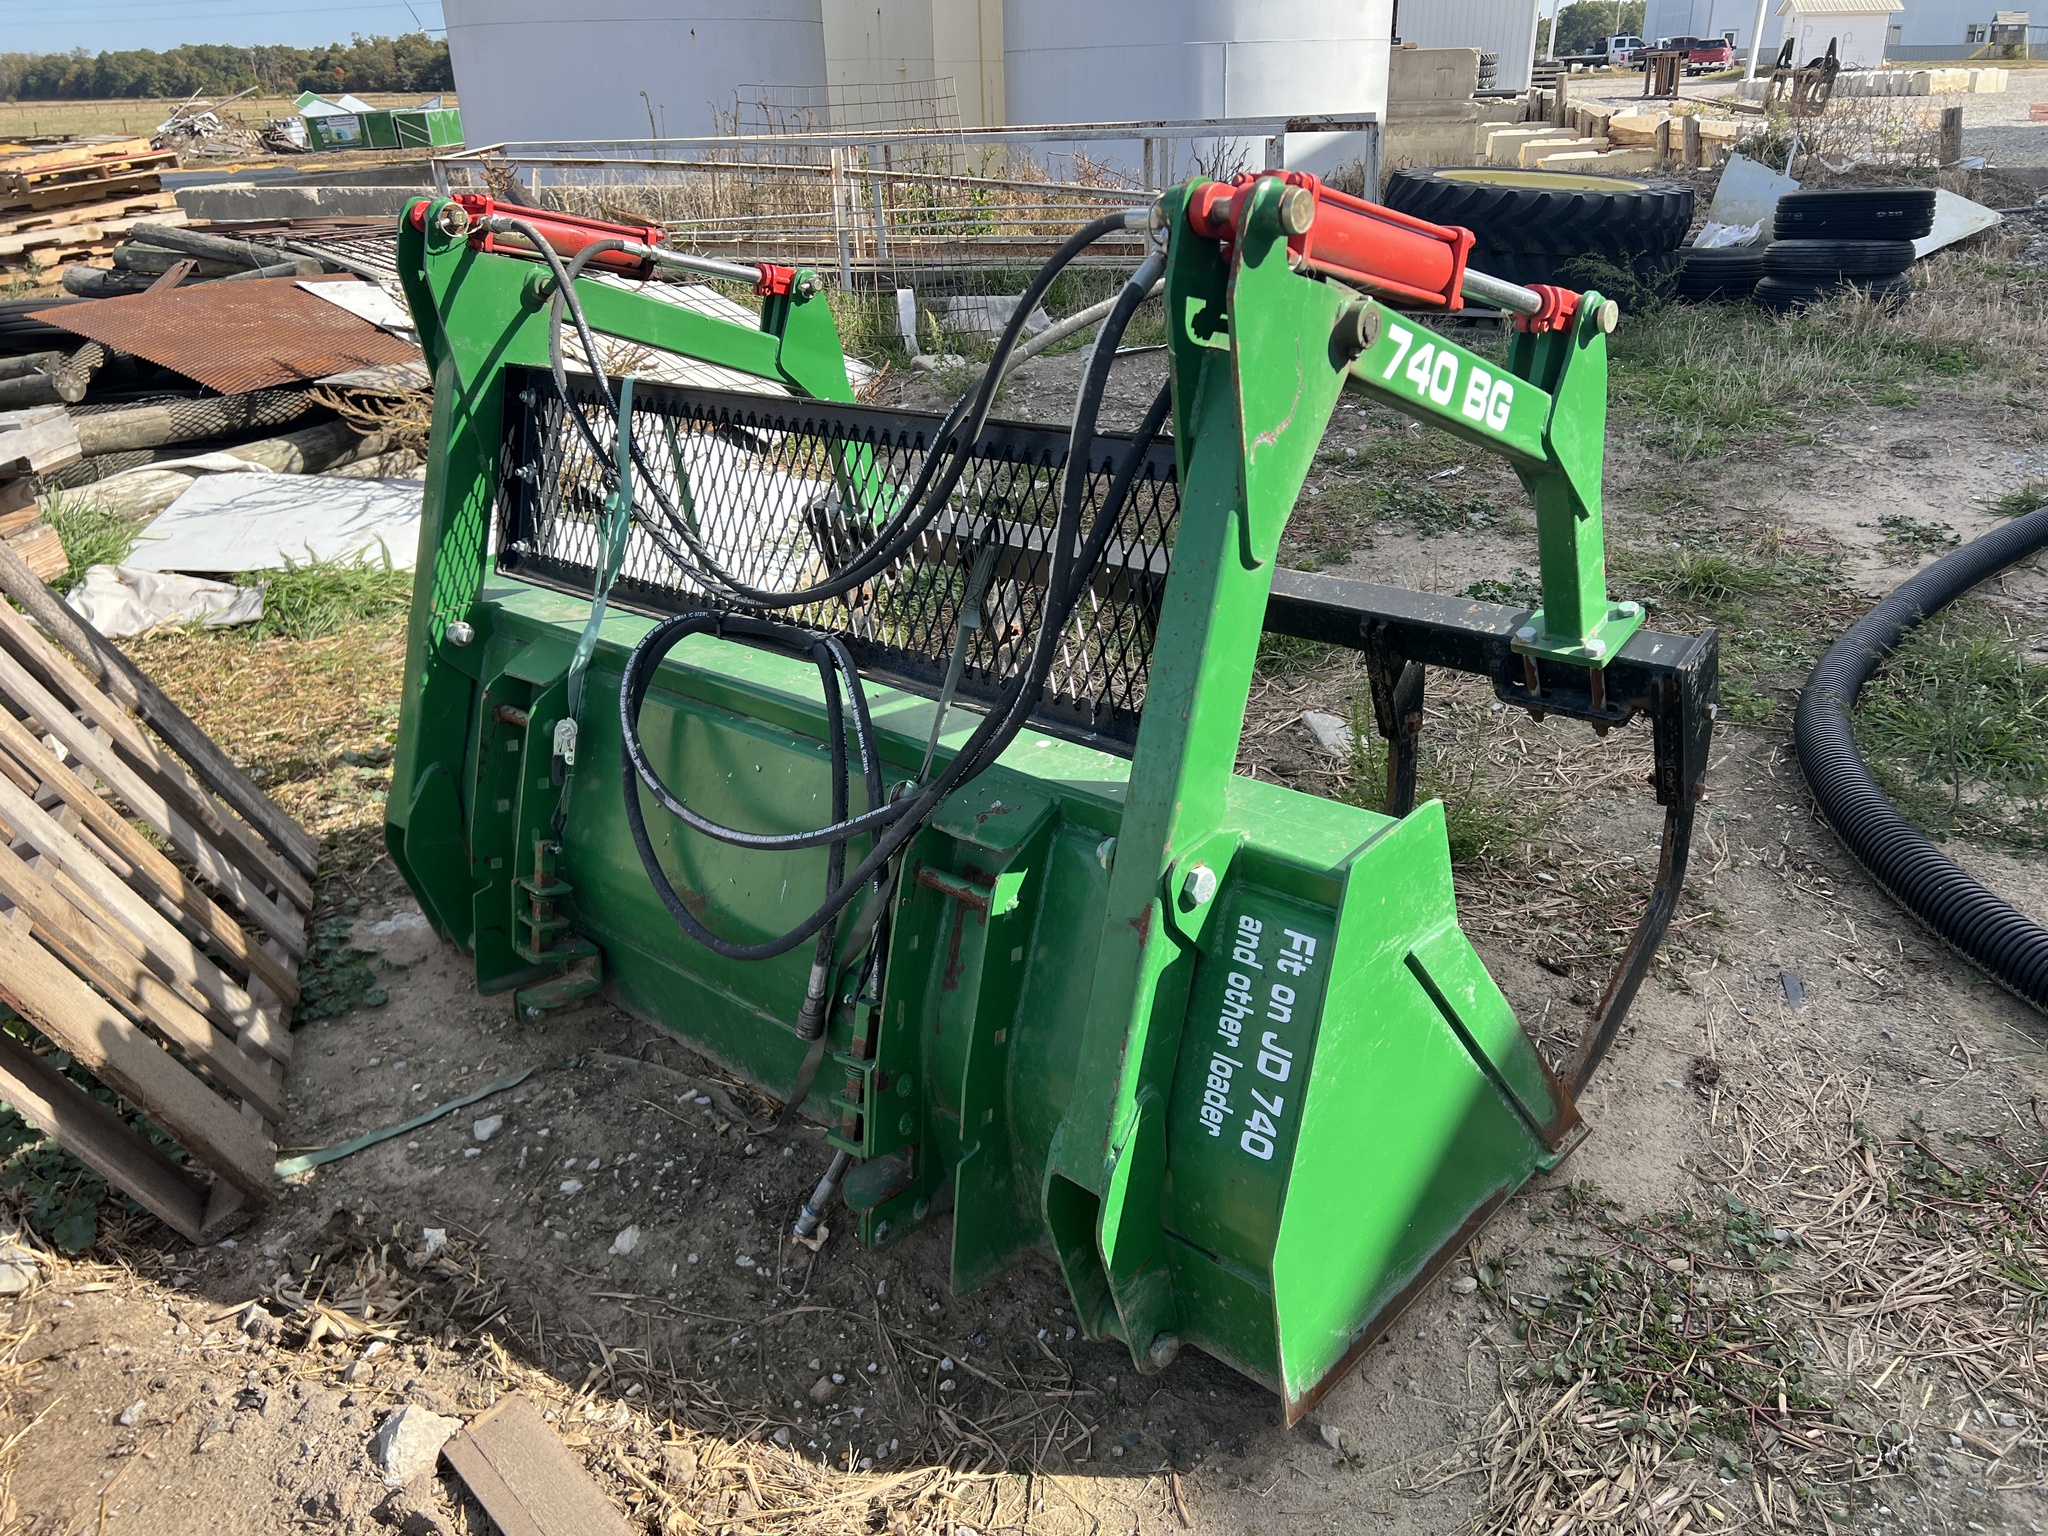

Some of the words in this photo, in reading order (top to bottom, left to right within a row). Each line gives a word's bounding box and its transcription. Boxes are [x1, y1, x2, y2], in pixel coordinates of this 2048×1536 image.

[1382, 323, 1459, 406] 740
[1462, 366, 1514, 432] BG
[1232, 914, 1264, 970] and
[1276, 928, 1317, 977] Fit
[1217, 971, 1254, 1048] other
[1266, 983, 1296, 1023] on
[1256, 1031, 1293, 1082] JD
[1199, 1051, 1244, 1138] loader
[1240, 1087, 1284, 1161] 740
